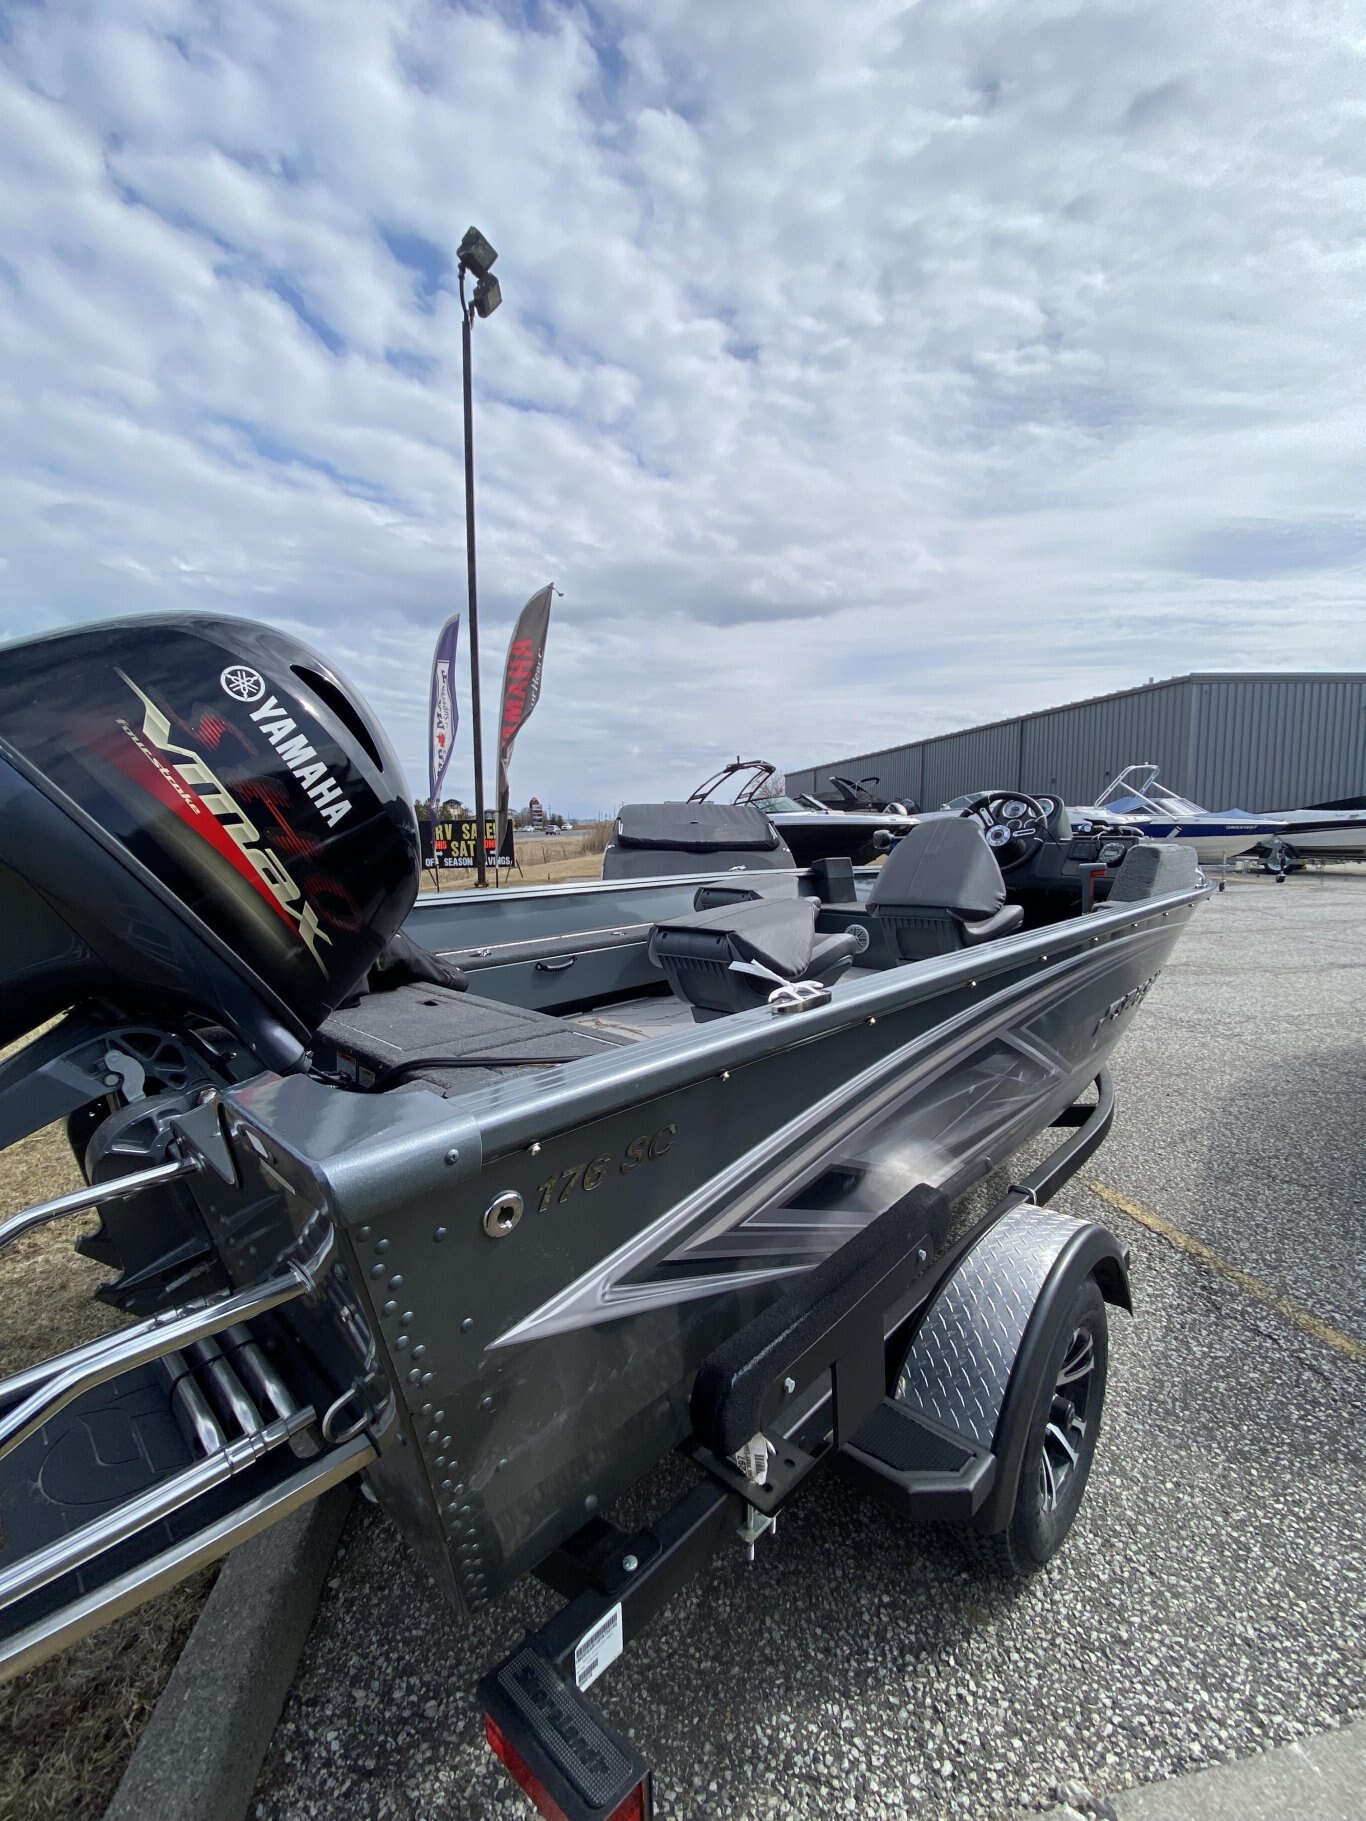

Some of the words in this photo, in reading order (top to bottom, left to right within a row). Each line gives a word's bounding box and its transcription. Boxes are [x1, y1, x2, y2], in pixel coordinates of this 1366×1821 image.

[500, 639, 534, 748] AMAHA
[249, 695, 353, 828] YAMAHA
[435, 823, 453, 840] RV
[434, 840, 448, 850] HIS
[450, 841, 476, 857] SAT
[425, 858, 438, 867] OF
[443, 857, 473, 867] SEASON
[537, 1152, 612, 1213] 176
[619, 1123, 678, 1174] SC
